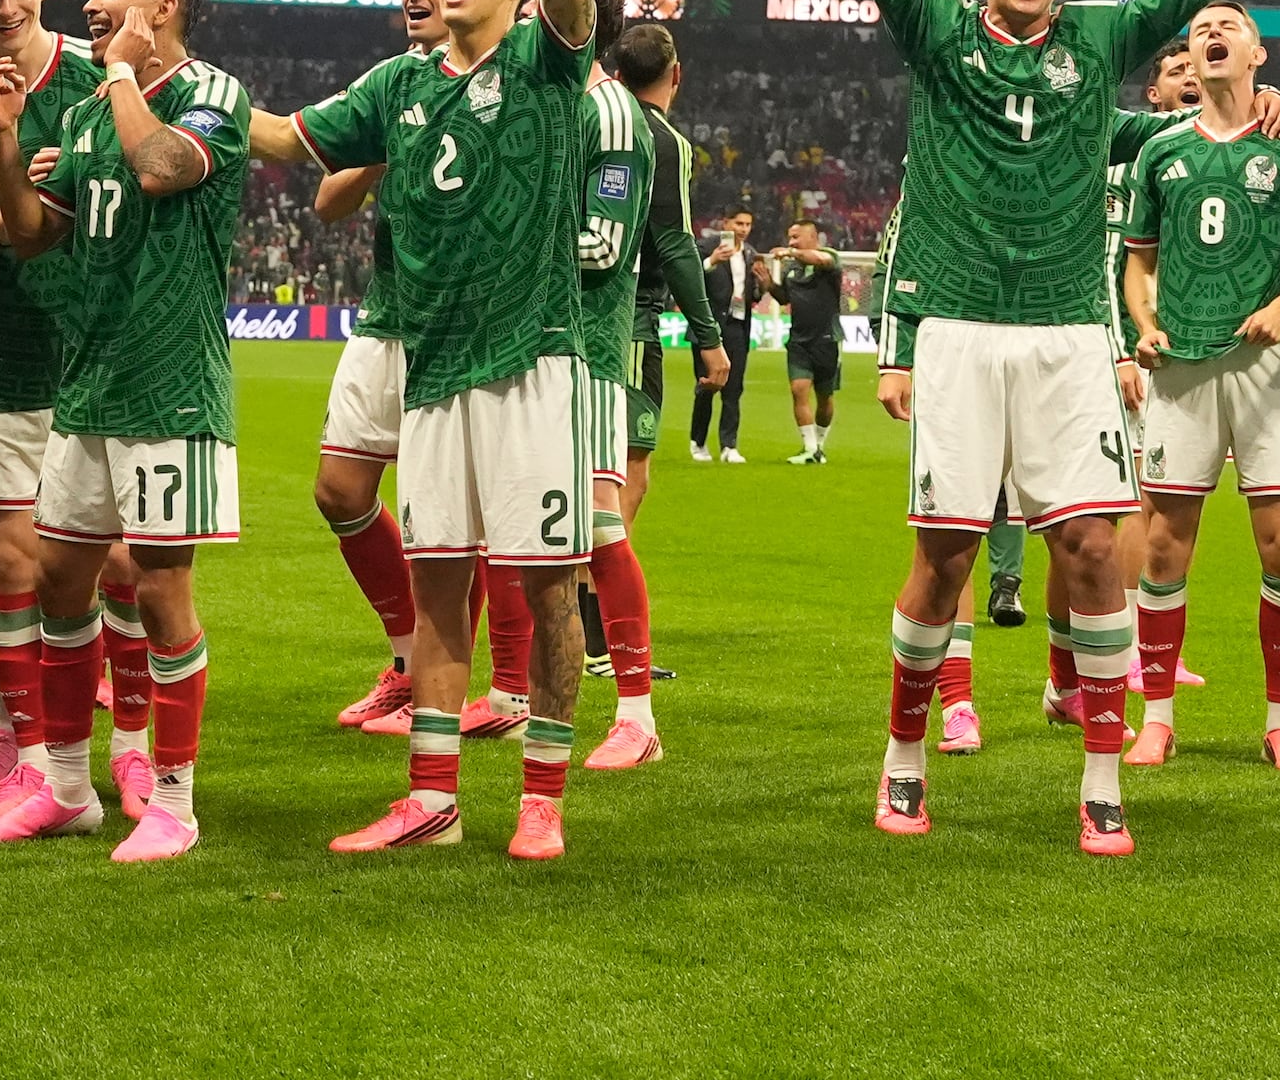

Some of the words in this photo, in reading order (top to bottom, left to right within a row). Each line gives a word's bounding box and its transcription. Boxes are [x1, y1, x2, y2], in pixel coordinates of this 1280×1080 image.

[1005, 94, 1034, 141] 4
[433, 133, 463, 191] 2
[88, 179, 122, 238] 17
[1200, 197, 1225, 245] 8
[226, 308, 299, 339] helob
[1100, 430, 1127, 483] 4
[136, 464, 182, 523] 17
[541, 489, 568, 546] 2
